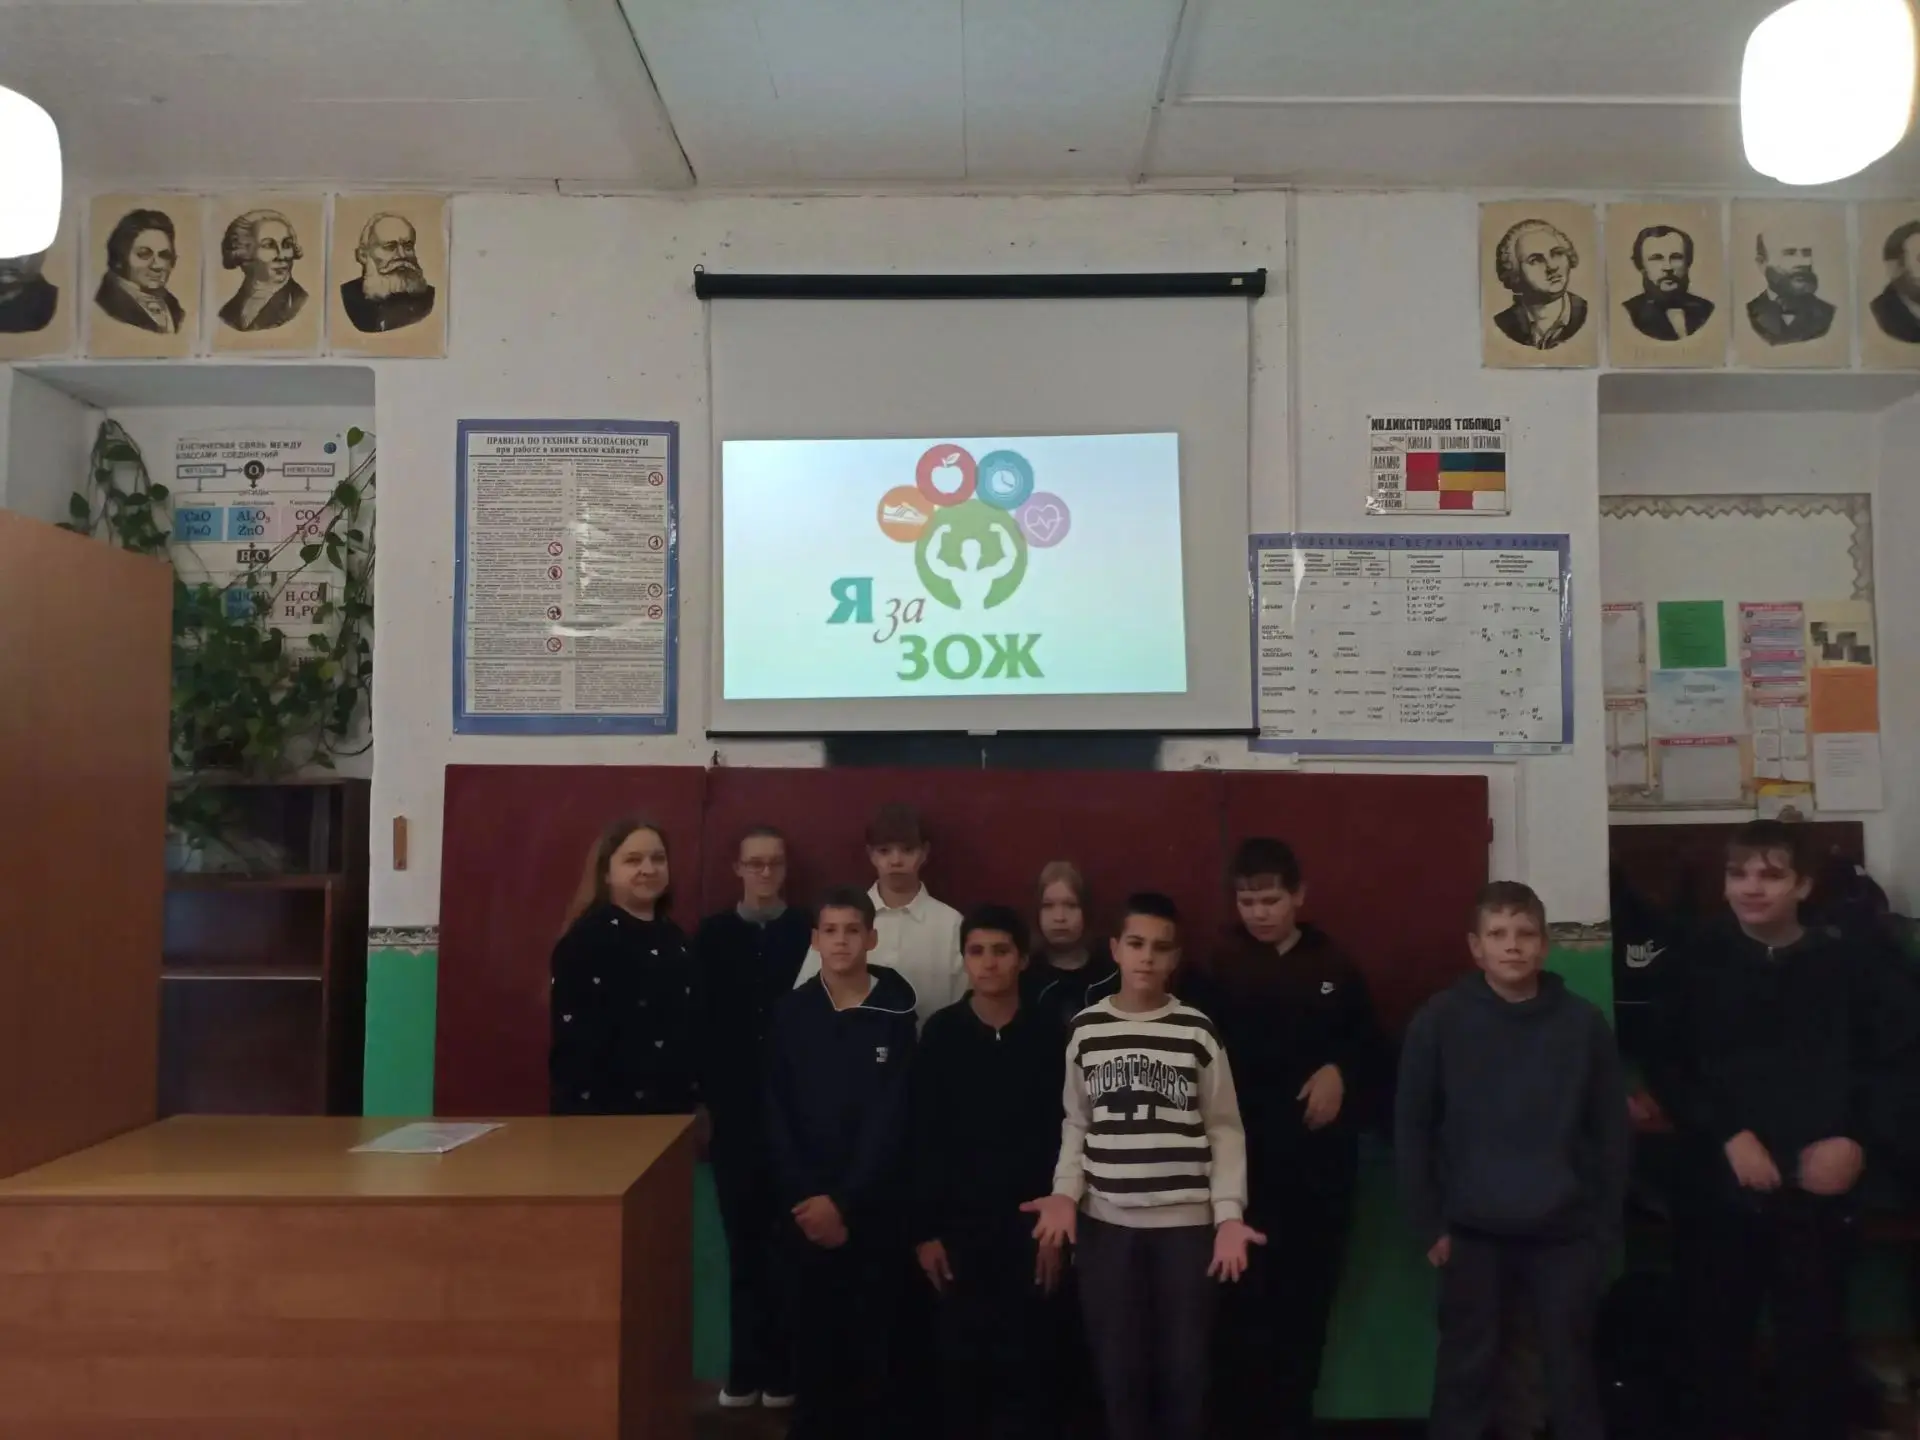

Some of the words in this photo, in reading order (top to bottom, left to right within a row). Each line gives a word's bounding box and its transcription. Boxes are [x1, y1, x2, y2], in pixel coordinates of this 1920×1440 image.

[1454, 418, 1501, 432] ТАБЛИЦА
[486, 436, 525, 445] ПРАВИЛА
[527, 436, 539, 445] ПО
[541, 436, 579, 445] ТЕХНИКЕ
[582, 437, 649, 447] БЕЗОПАСНОСТИ
[513, 446, 541, 455] работе
[601, 446, 640, 455] кабинете
[826, 577, 874, 624] Я
[872, 597, 927, 643] за
[896, 633, 1045, 681] ЗОЖ
